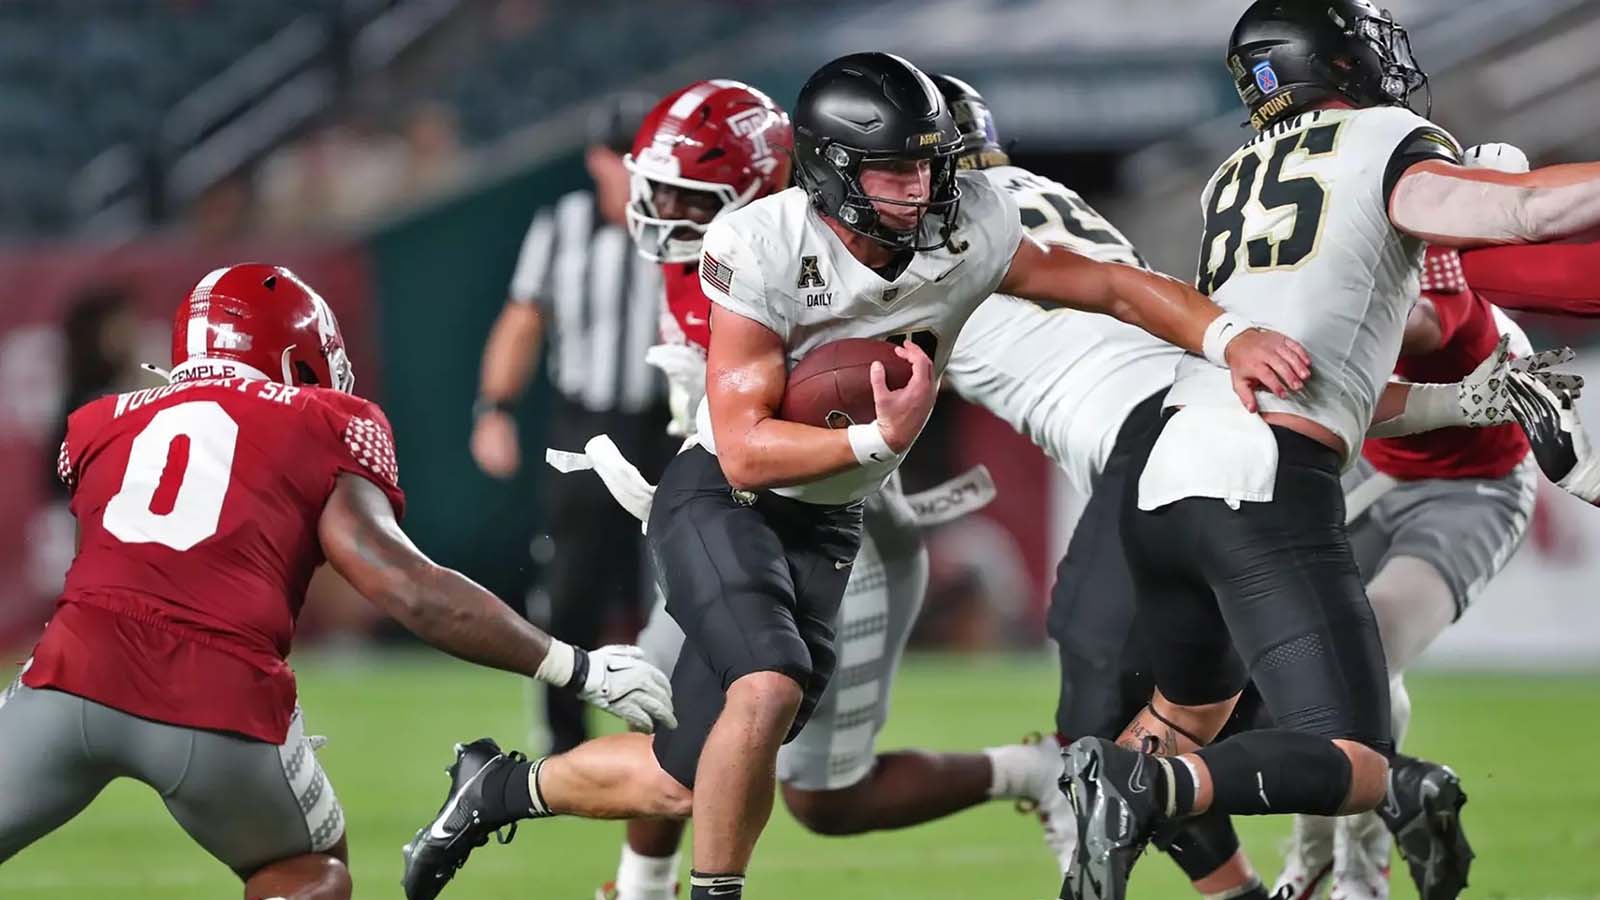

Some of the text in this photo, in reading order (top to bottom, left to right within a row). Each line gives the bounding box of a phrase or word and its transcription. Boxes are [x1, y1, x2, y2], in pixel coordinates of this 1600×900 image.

[1258, 91, 1293, 121] POINT
[920, 132, 942, 146] ARMY
[1198, 121, 1341, 297] 85
[798, 255, 826, 289] A
[806, 292, 833, 308] DAILY
[171, 364, 236, 384] TEMPLE
[257, 381, 300, 405] SR
[102, 400, 239, 552] 0
